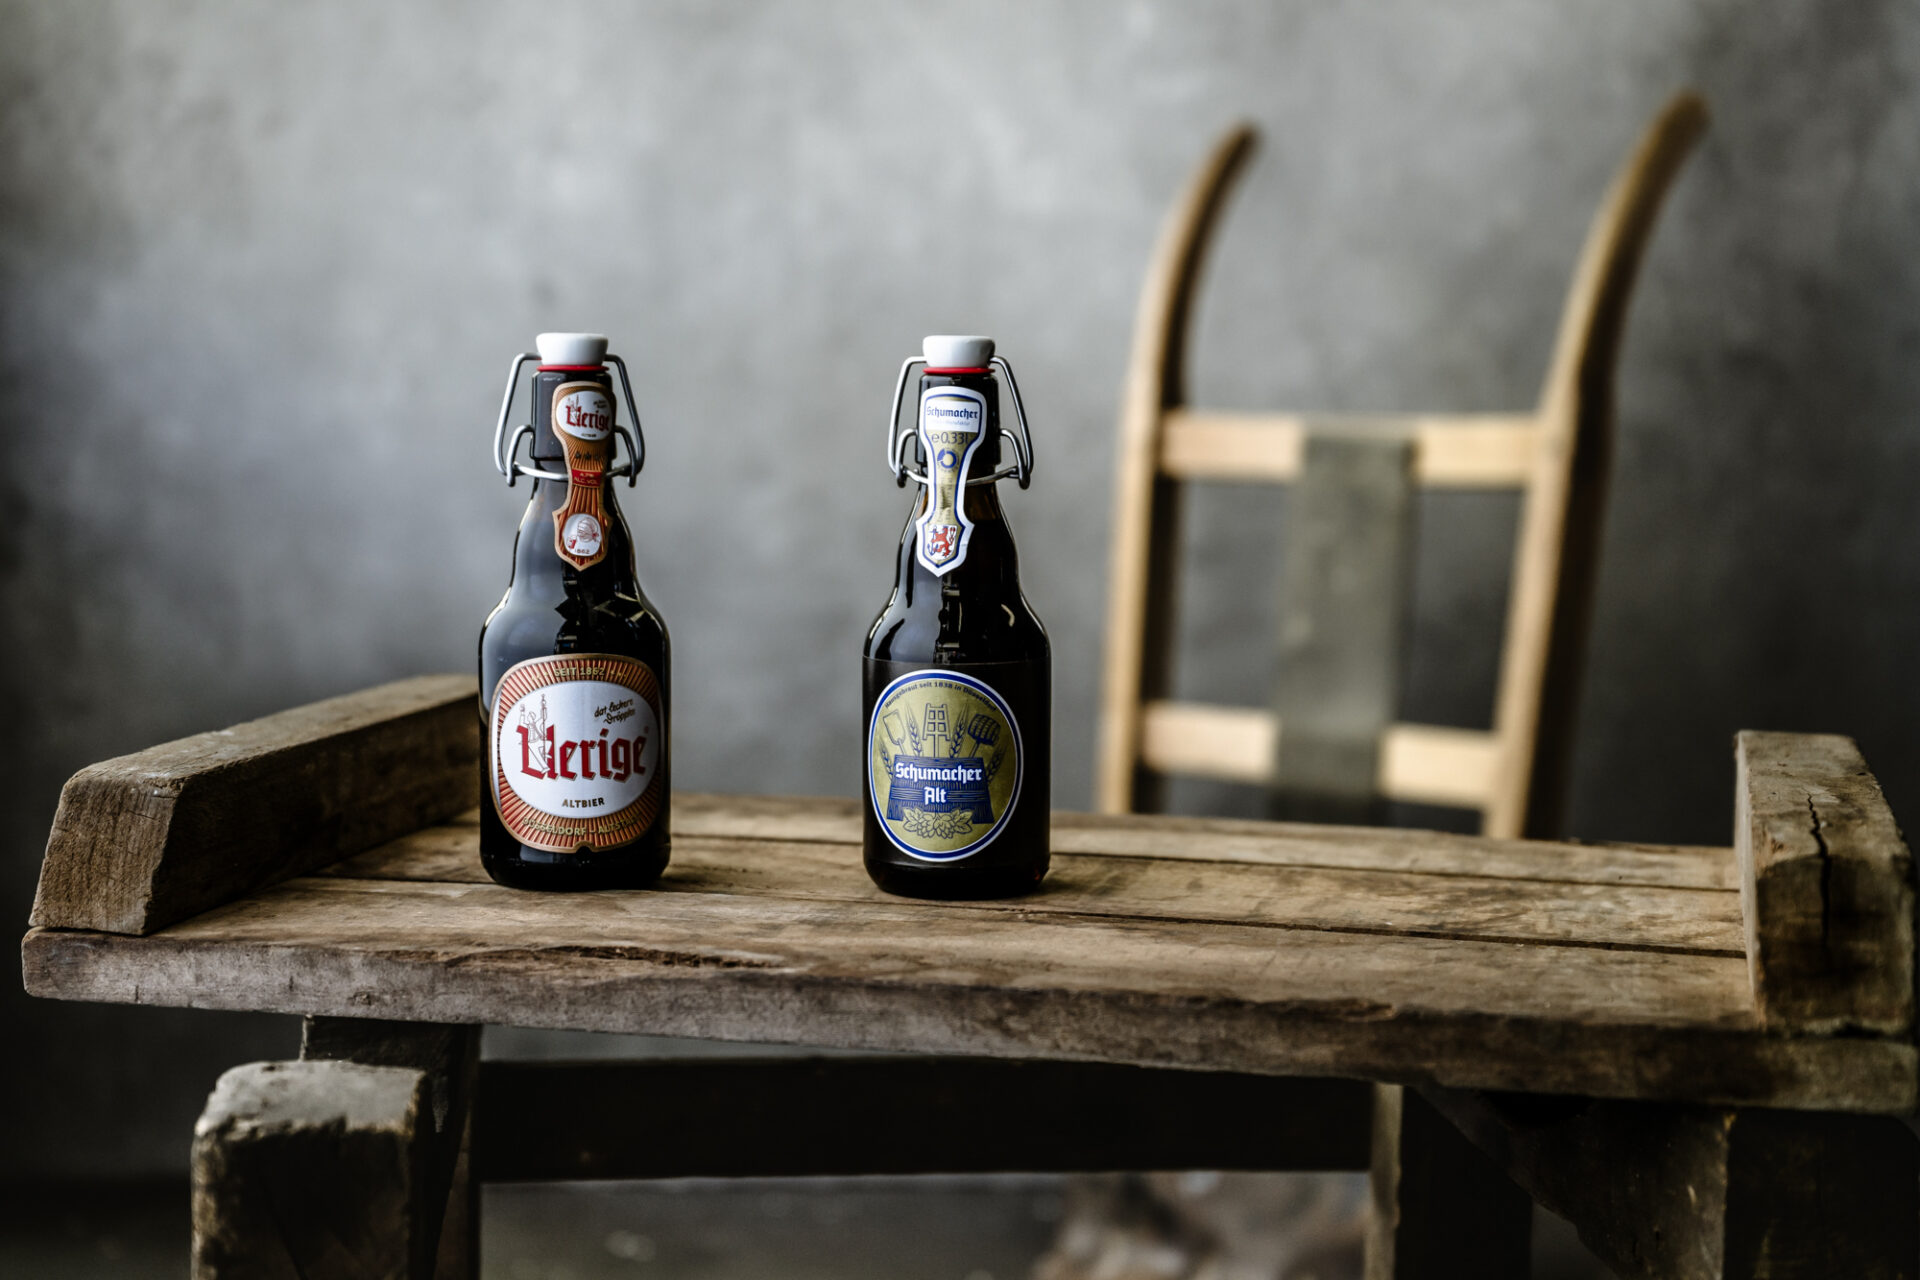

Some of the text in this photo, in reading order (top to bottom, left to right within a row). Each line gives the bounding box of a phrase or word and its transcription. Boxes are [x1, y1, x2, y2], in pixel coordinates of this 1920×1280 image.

[926, 405, 979, 420] Schumacher
[554, 666, 605, 678] SEIT 1862
[919, 681, 932, 689] seit
[934, 681, 953, 689] 1838
[516, 724, 649, 784] Uerige
[895, 762, 983, 784] Schumacher
[562, 797, 605, 808] ALTBIER
[923, 786, 947, 805] Alt
[521, 817, 587, 837] DÜSSELDORF
